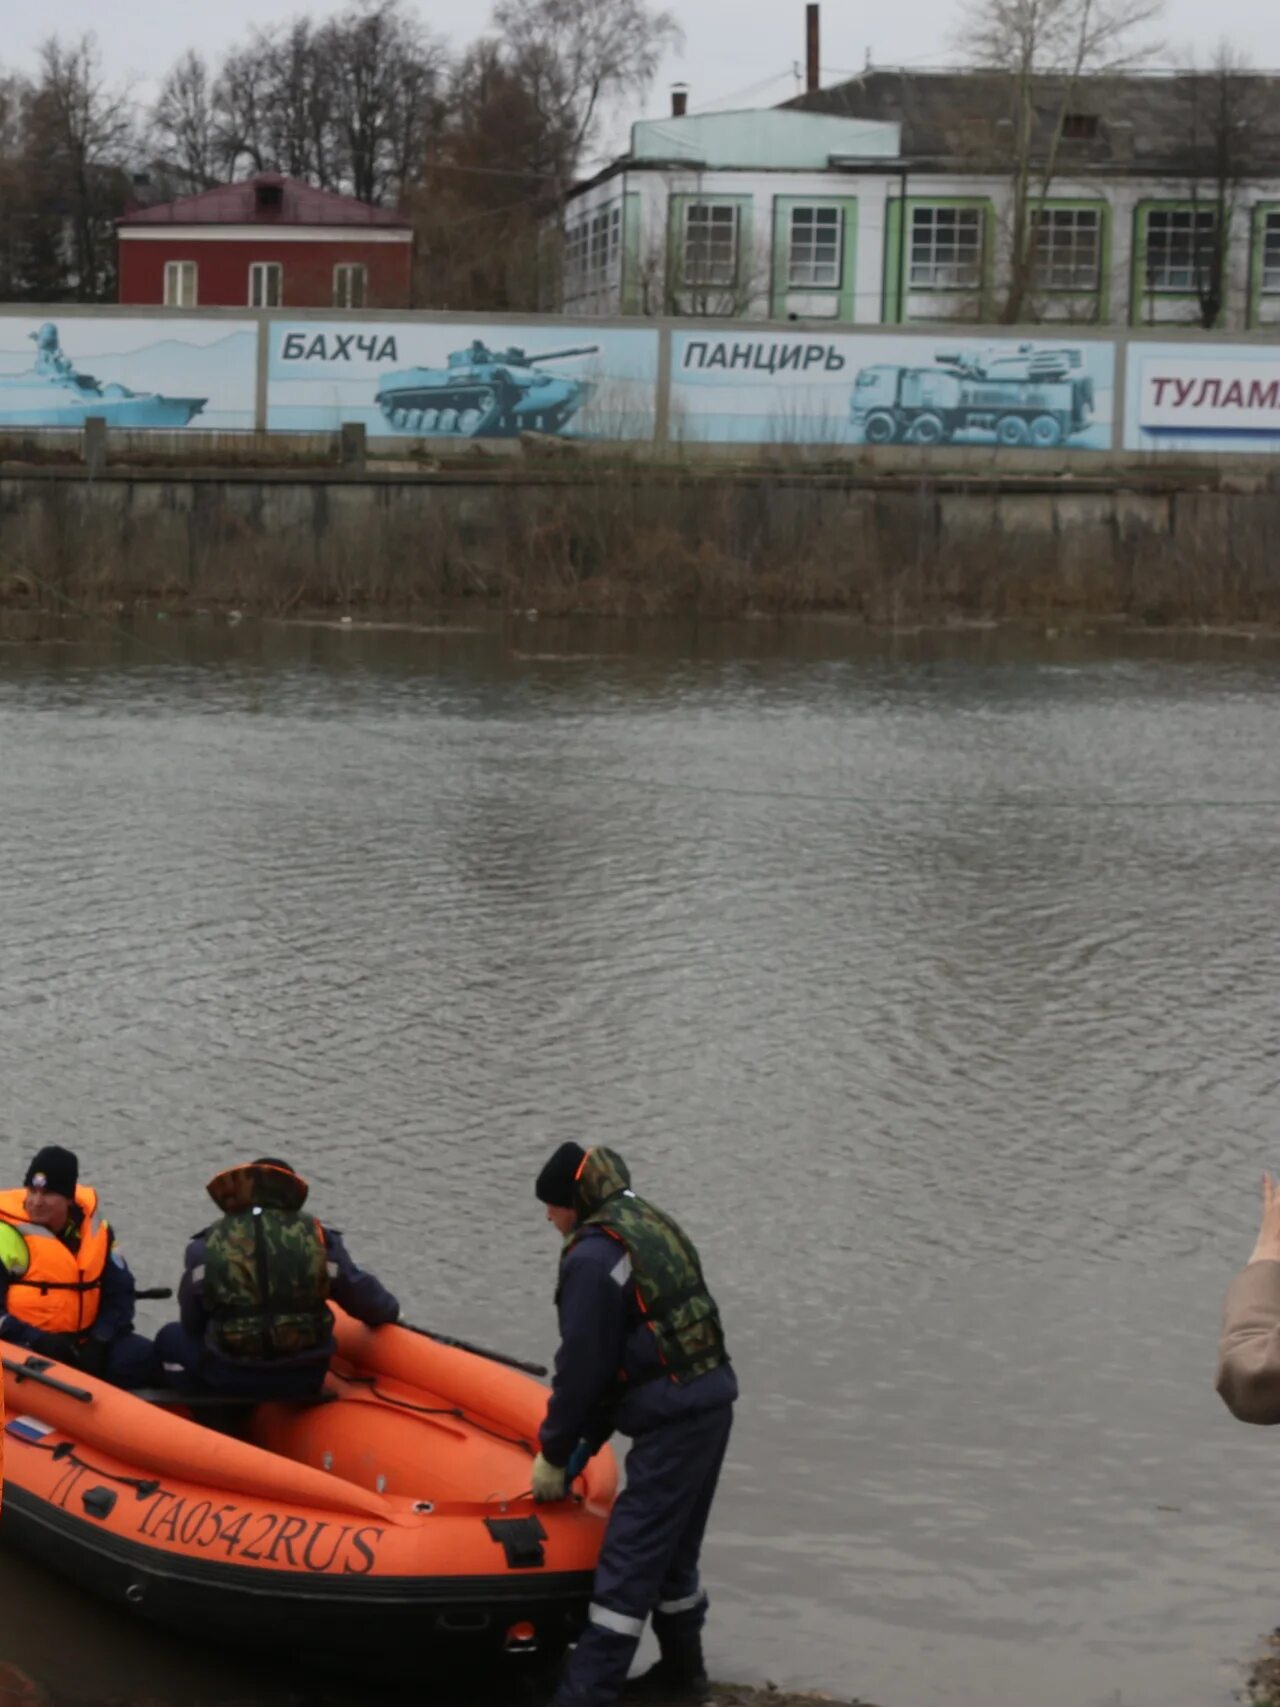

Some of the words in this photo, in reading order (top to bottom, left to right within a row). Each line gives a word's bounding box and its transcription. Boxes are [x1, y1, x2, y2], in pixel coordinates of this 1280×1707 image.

[282, 333, 398, 362] БАХЧА
[683, 342, 845, 375] ПАНЦИРЬ
[1151, 377, 1280, 409] ТУЛАМ
